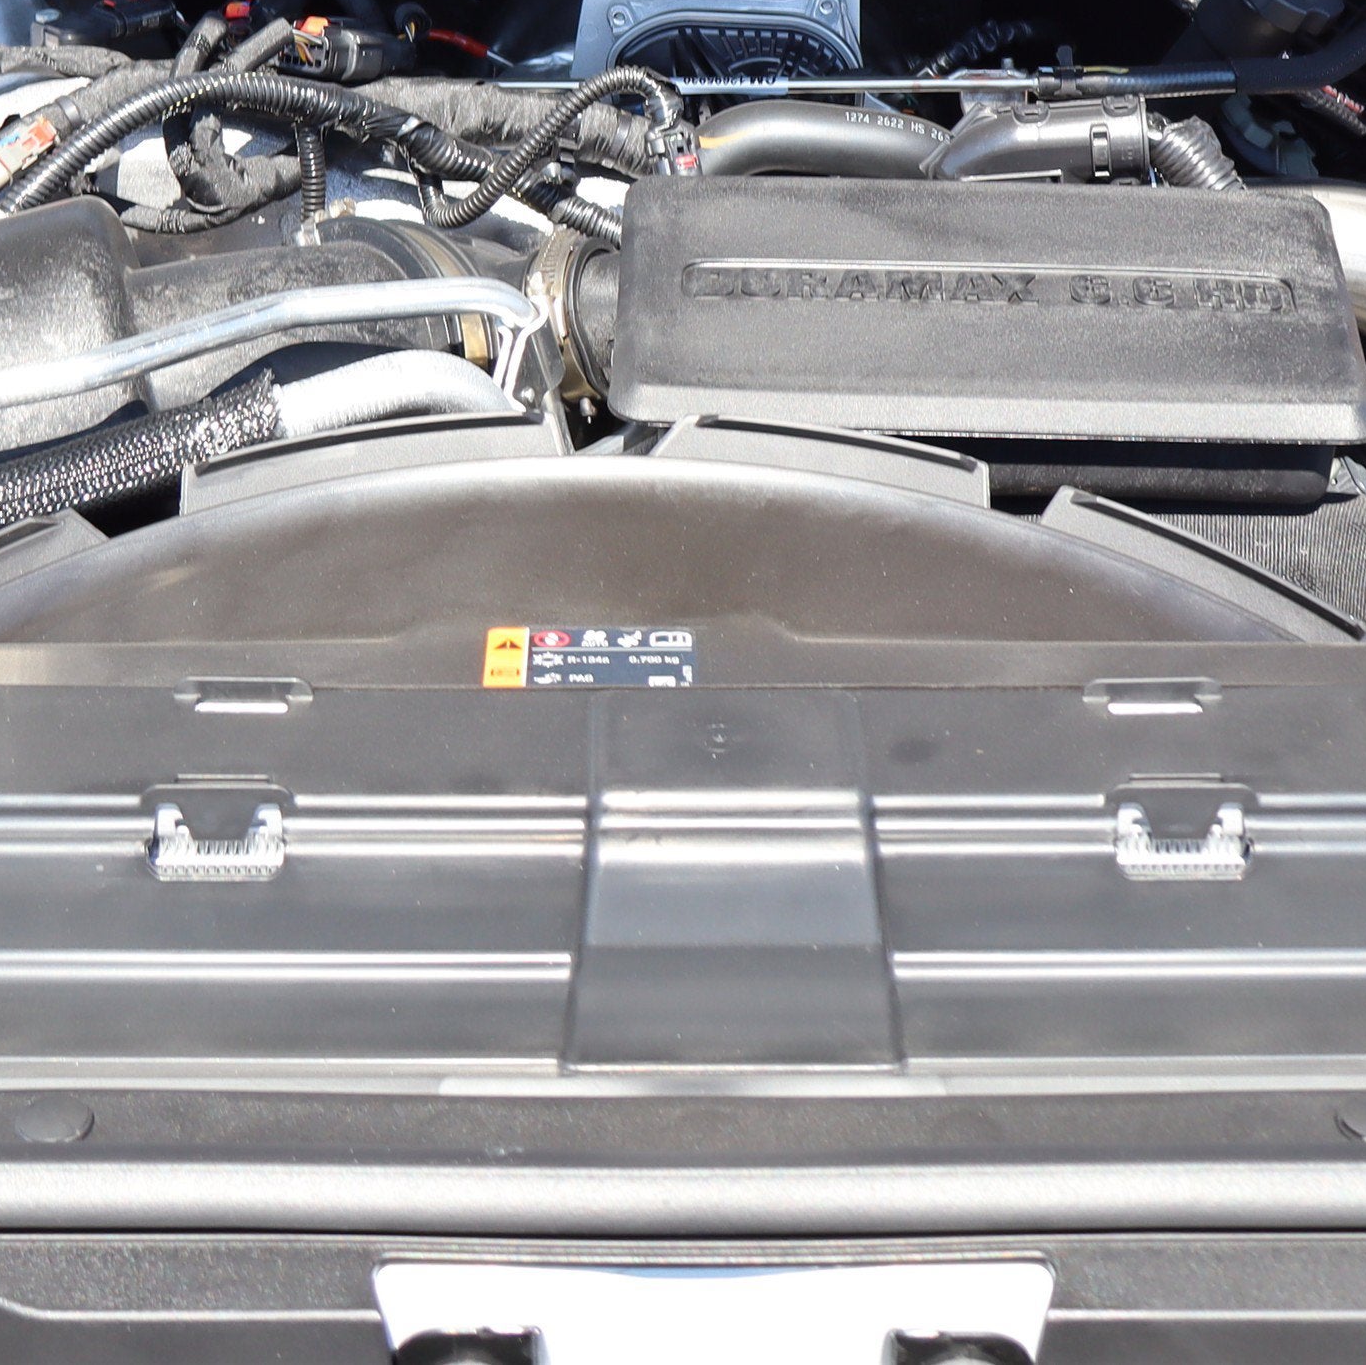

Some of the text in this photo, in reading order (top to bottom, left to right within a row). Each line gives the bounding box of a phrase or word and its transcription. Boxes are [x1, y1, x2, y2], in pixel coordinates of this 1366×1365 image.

[690, 266, 1286, 312] DURAMAX 6.6 HD
